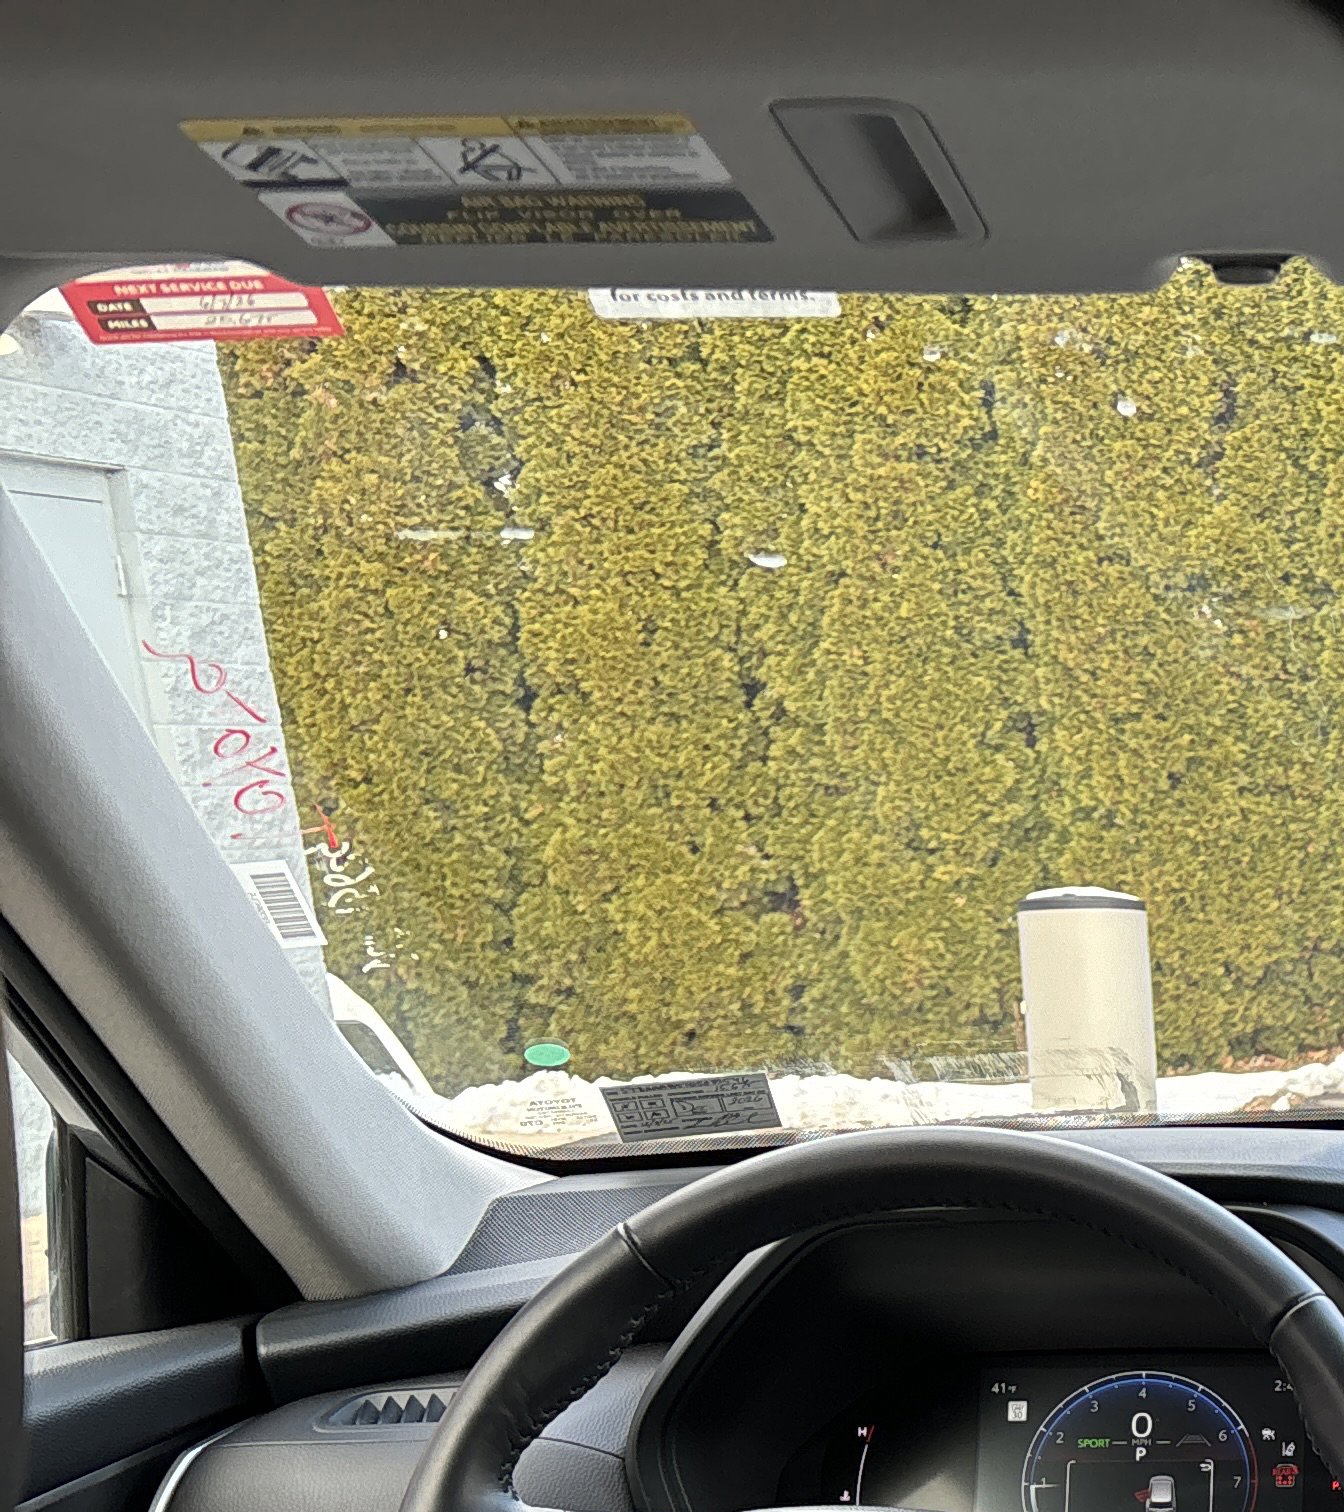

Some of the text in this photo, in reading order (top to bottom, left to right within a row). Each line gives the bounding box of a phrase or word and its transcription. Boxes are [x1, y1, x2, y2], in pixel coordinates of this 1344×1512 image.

[113, 280, 264, 297] NEXT SERVICE DUE
[646, 288, 699, 302] costs
[704, 289, 744, 302] and
[96, 302, 134, 313] DATE
[107, 318, 149, 330] MILES
[1274, 1379, 1294, 1392] 2:4
[1138, 1387, 1147, 1399] 4
[1090, 1400, 1099, 1412] 3
[1187, 1399, 1196, 1412] 5
[857, 1426, 868, 1437] H
[1131, 1412, 1153, 1438] 0
[1055, 1431, 1065, 1444] 2
[1218, 1429, 1228, 1442] 6
[1077, 1438, 1111, 1448] SPORT
[1131, 1438, 1152, 1447] MPH
[1135, 1447, 1147, 1462] P
[1233, 1475, 1242, 1489] 7
